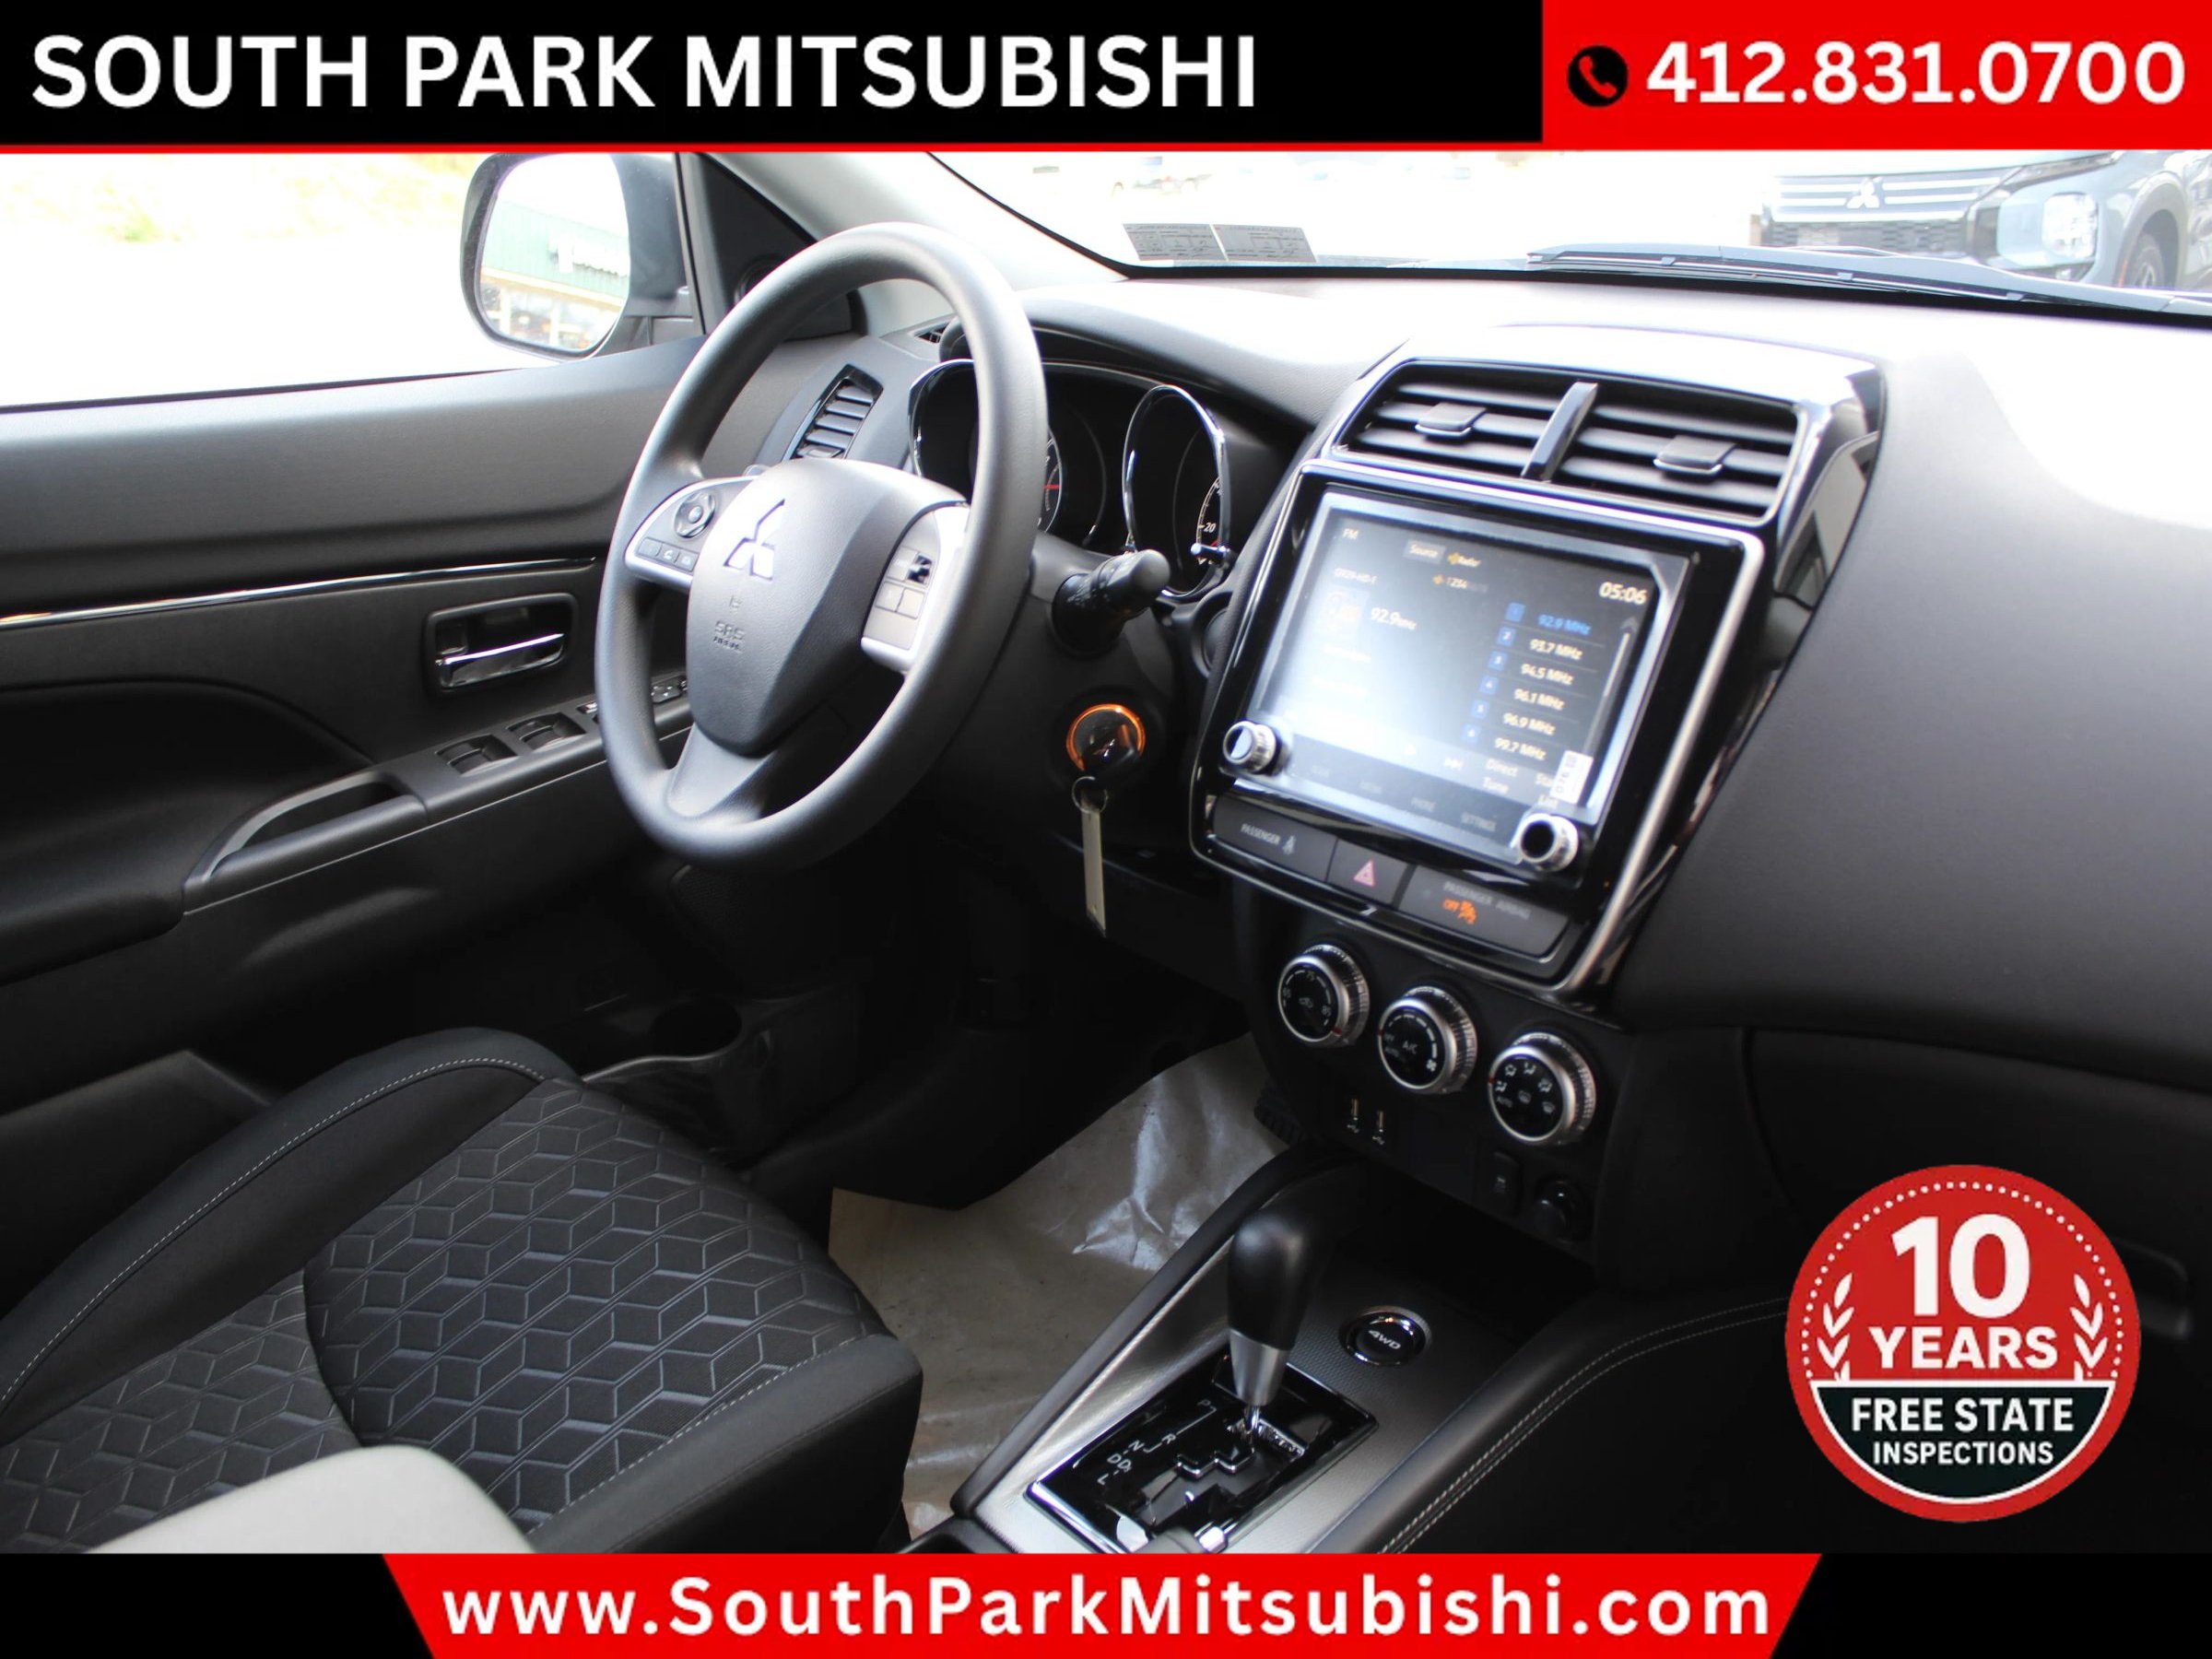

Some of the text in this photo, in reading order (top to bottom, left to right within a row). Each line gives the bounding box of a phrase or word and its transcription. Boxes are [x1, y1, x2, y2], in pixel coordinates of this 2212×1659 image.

[1204, 522, 1217, 533] 20
[1342, 528, 1359, 540] FM
[1598, 581, 1648, 605] 05:06
[1537, 614, 1564, 629] 92.9
[1241, 822, 1281, 846] PASSENGER
[1368, 1330, 1401, 1349] 4WD
[1162, 1433, 1176, 1444] R
[1128, 1440, 1145, 1453] N
[1107, 1453, 1122, 1465] D
[1097, 1474, 1109, 1486] L
